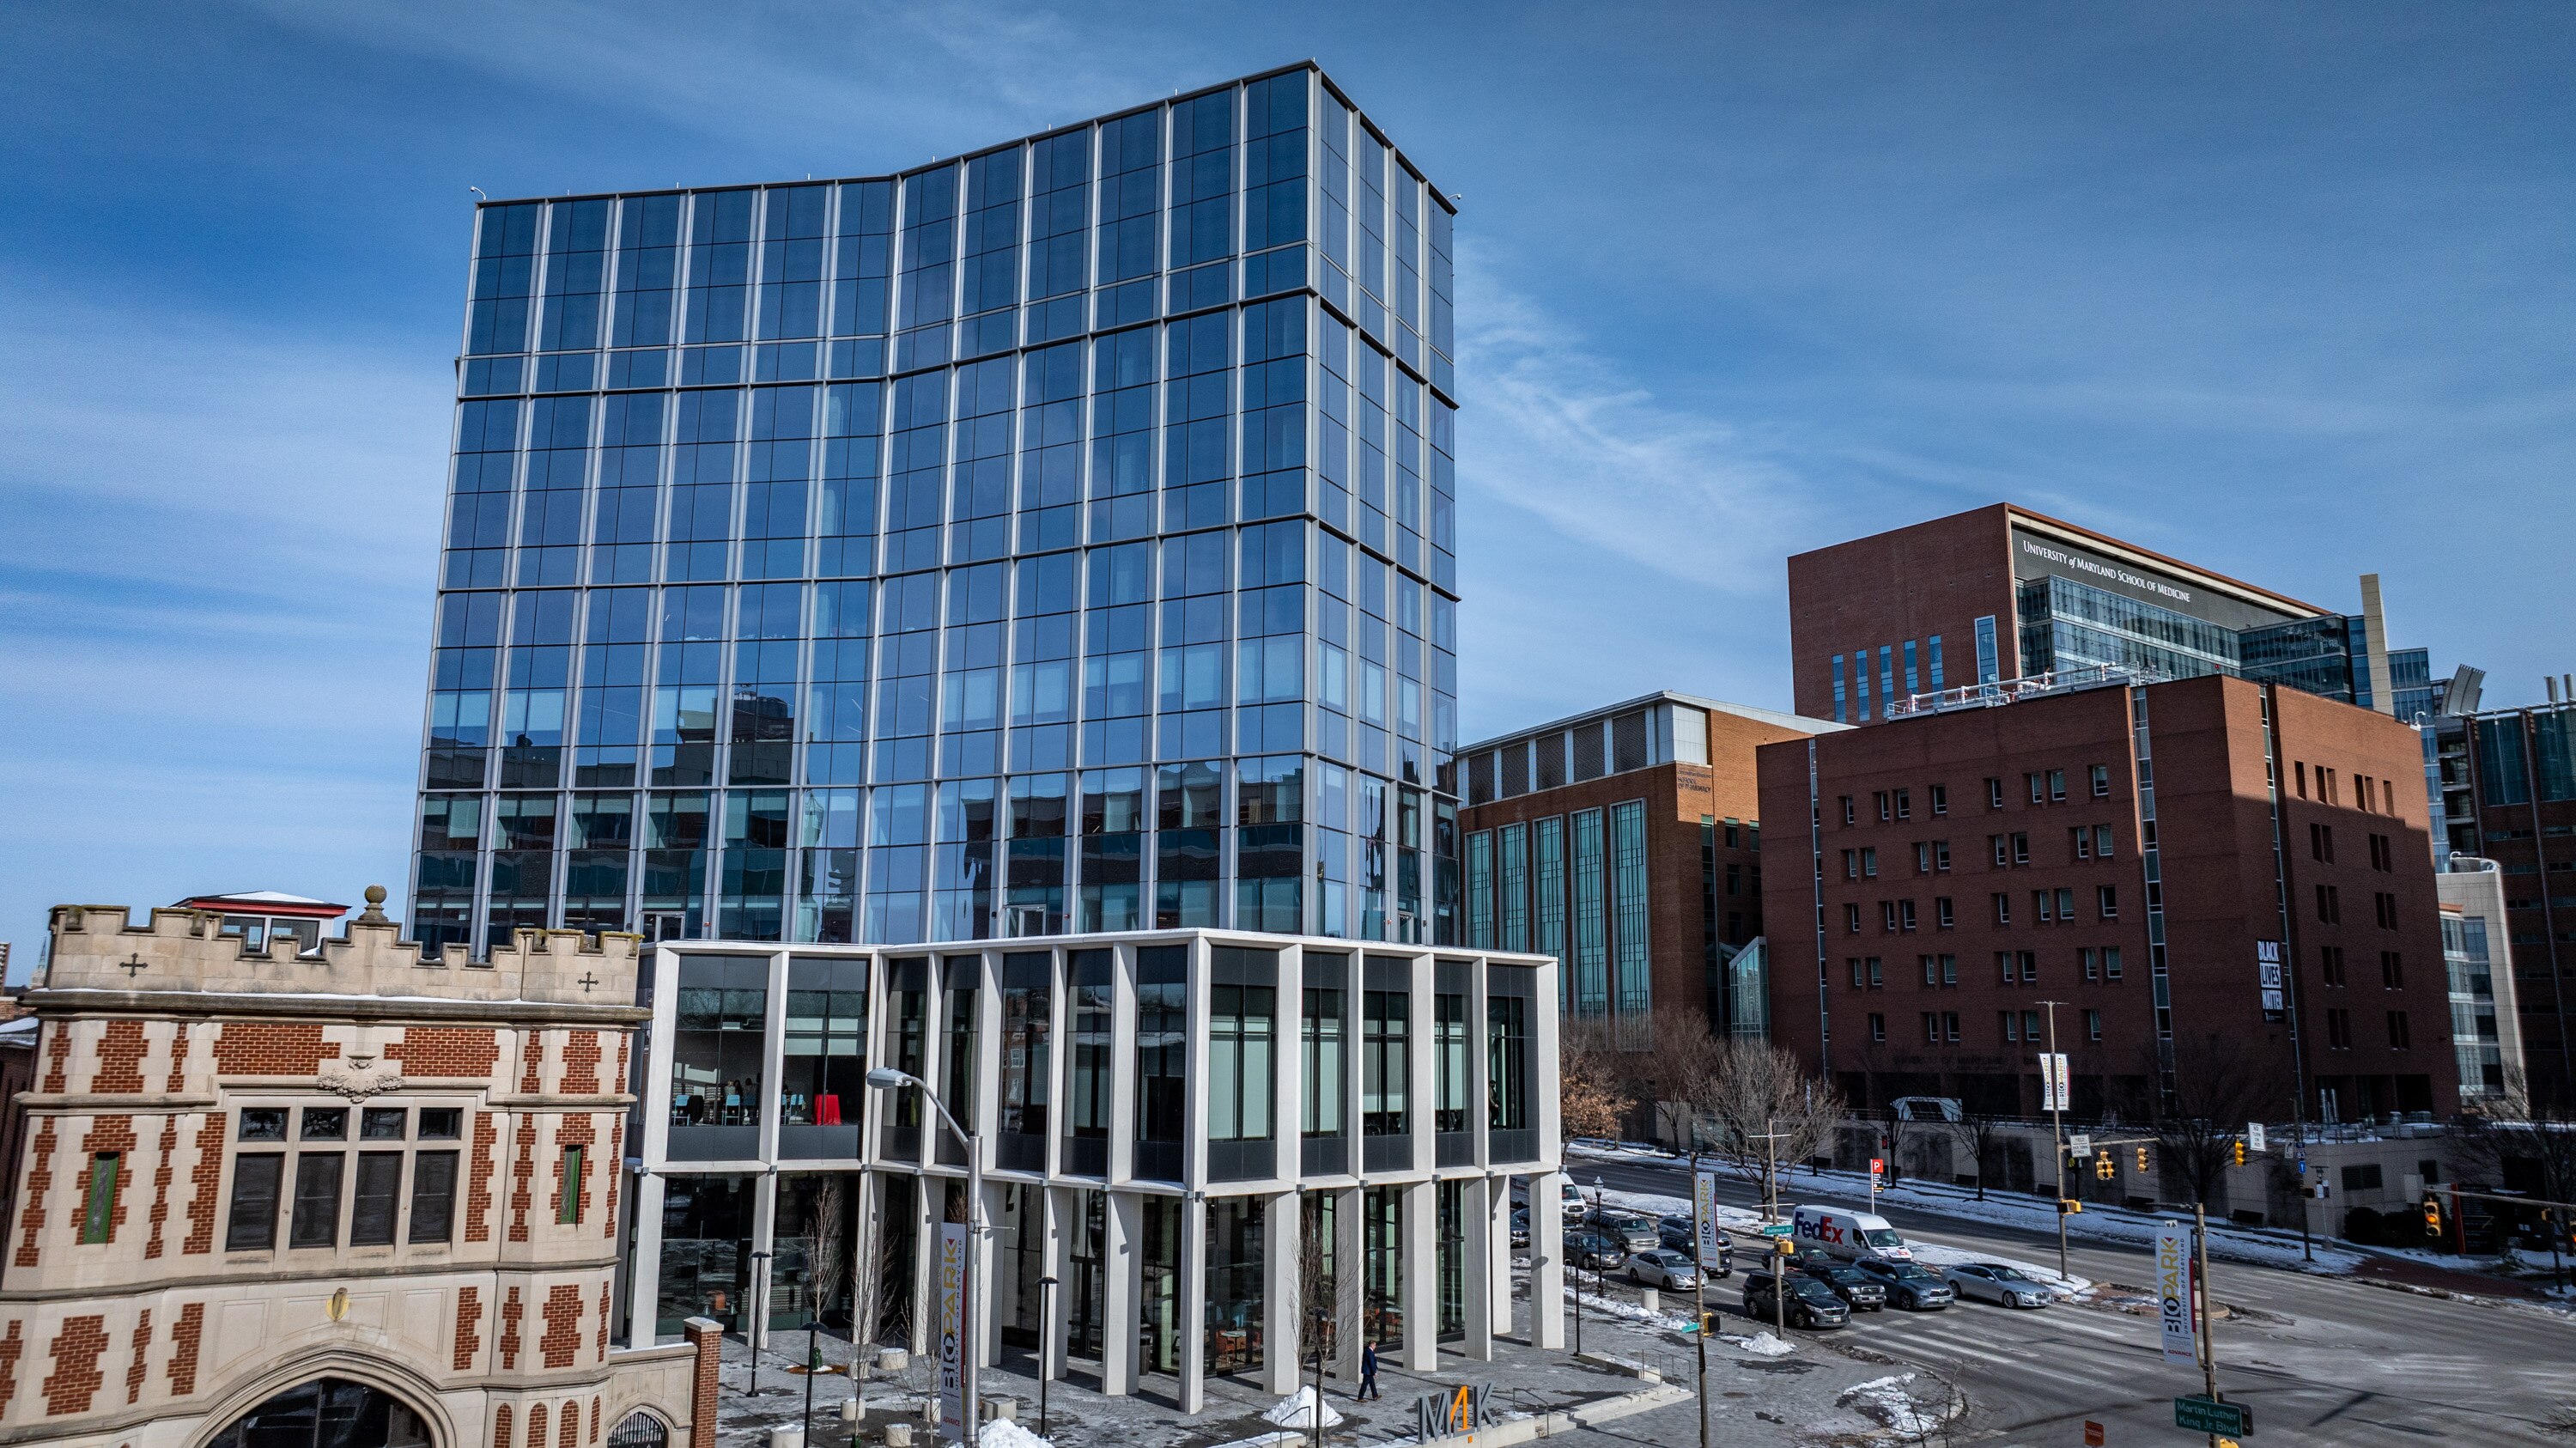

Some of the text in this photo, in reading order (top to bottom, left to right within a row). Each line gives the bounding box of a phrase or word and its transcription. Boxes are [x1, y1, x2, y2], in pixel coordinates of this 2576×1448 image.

[2023, 539, 2191, 602] UNIVERSITY of MARYLAND SCHOOL OF MEDICINE
[2257, 940, 2280, 962] BLACK
[2260, 965, 2280, 986] LIVES
[2261, 989, 2284, 1010] MATTER
[1700, 1179, 1711, 1245] BIOPARK
[1795, 1211, 1844, 1244] FedEx
[2160, 1238, 2182, 1333] BIOPARK
[944, 1239, 957, 1388] BIOPARK
[956, 1305, 960, 1318] OF
[2177, 1401, 2238, 1421] Martin Luther
[2178, 1415, 2240, 1435] King Jr. Blvd.
